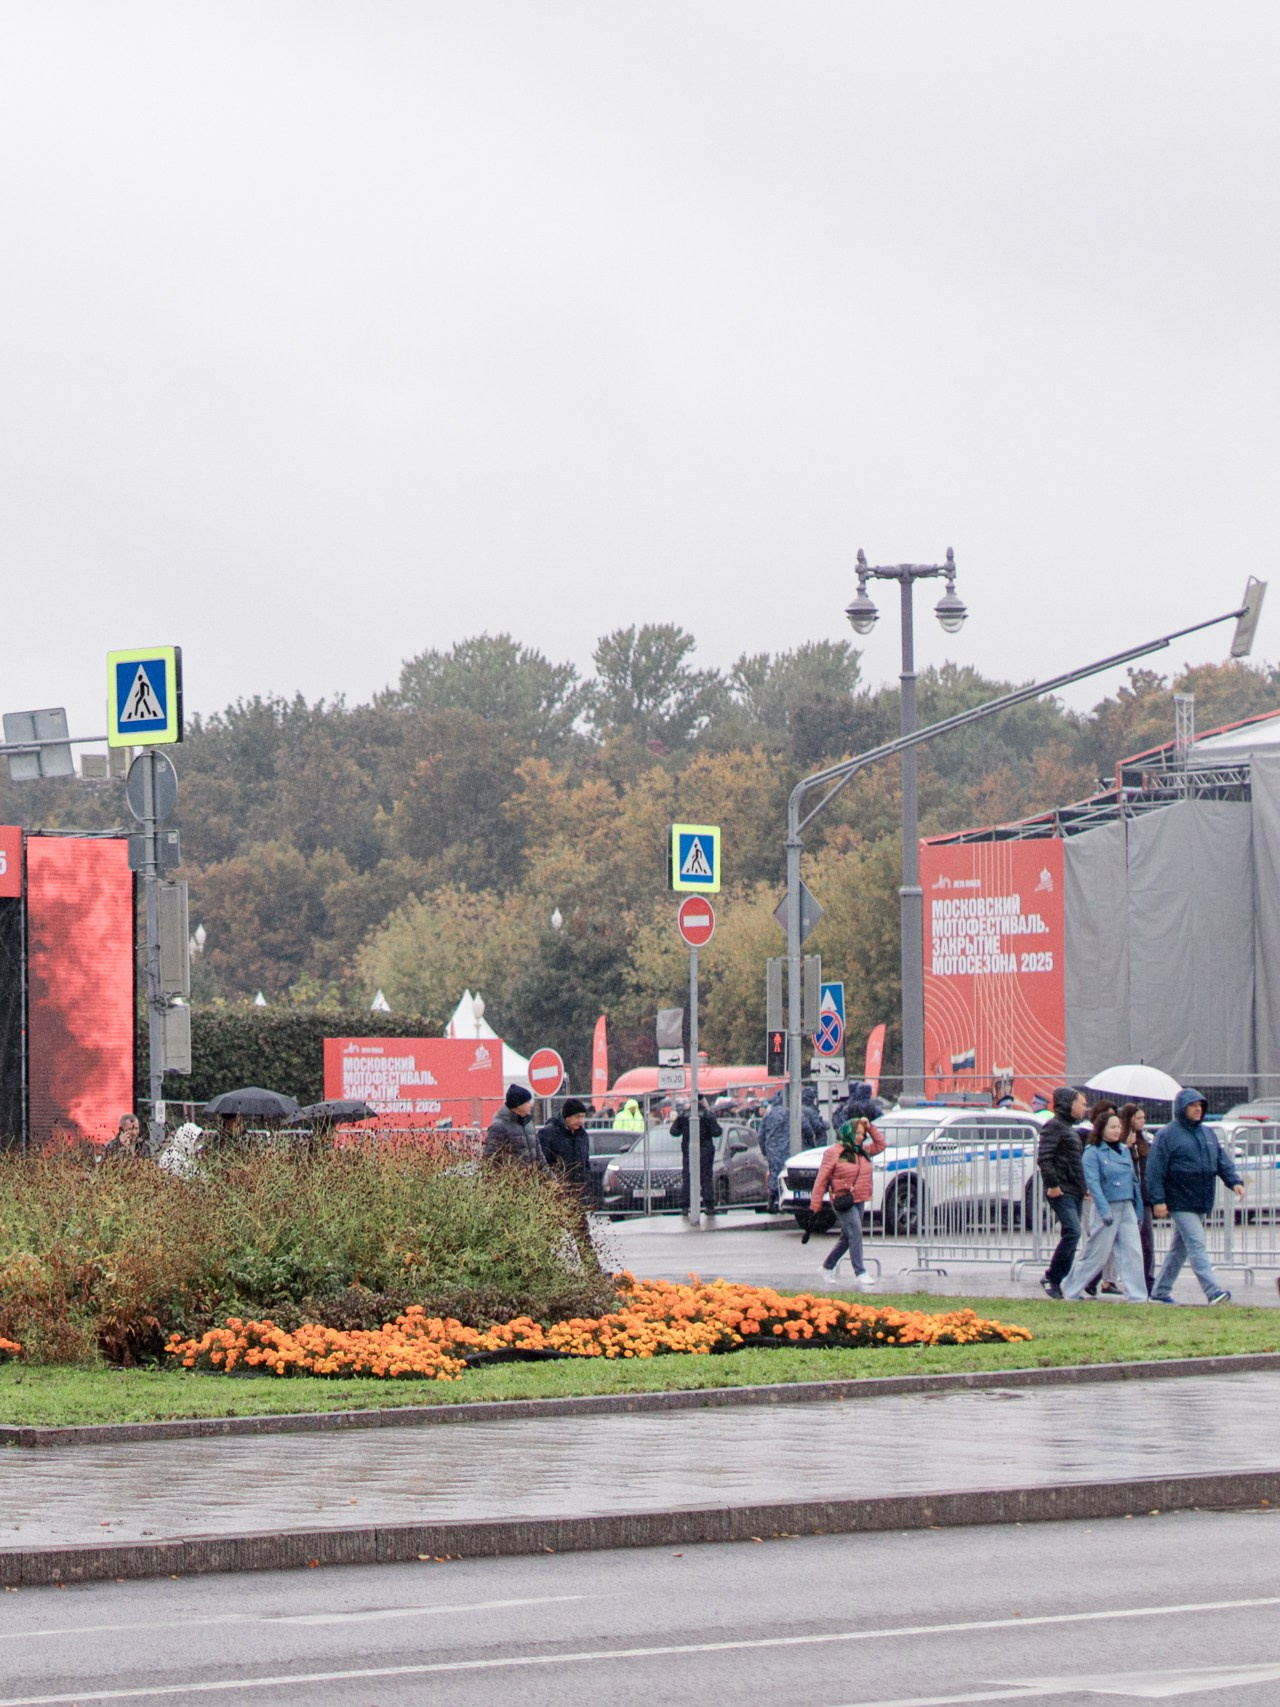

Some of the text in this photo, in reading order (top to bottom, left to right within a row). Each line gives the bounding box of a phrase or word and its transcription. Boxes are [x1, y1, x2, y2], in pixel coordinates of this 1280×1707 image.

[932, 893, 1020, 918] МОСКОВСКИЙ
[932, 914, 1049, 937] МОТОФЕСТИВАЛЬ.
[932, 935, 1000, 956] ЗАКРЫТИЕ
[932, 952, 1053, 976] МОТОСЕЗОНА 2025
[343, 1056, 415, 1072] МОСКОВСКИЙ
[343, 1071, 437, 1085] МОТОФЕСТИВАЛЬ.
[343, 1085, 400, 1099] ЗАКРЫТИЕ
[415, 1099, 441, 1113] 2025
